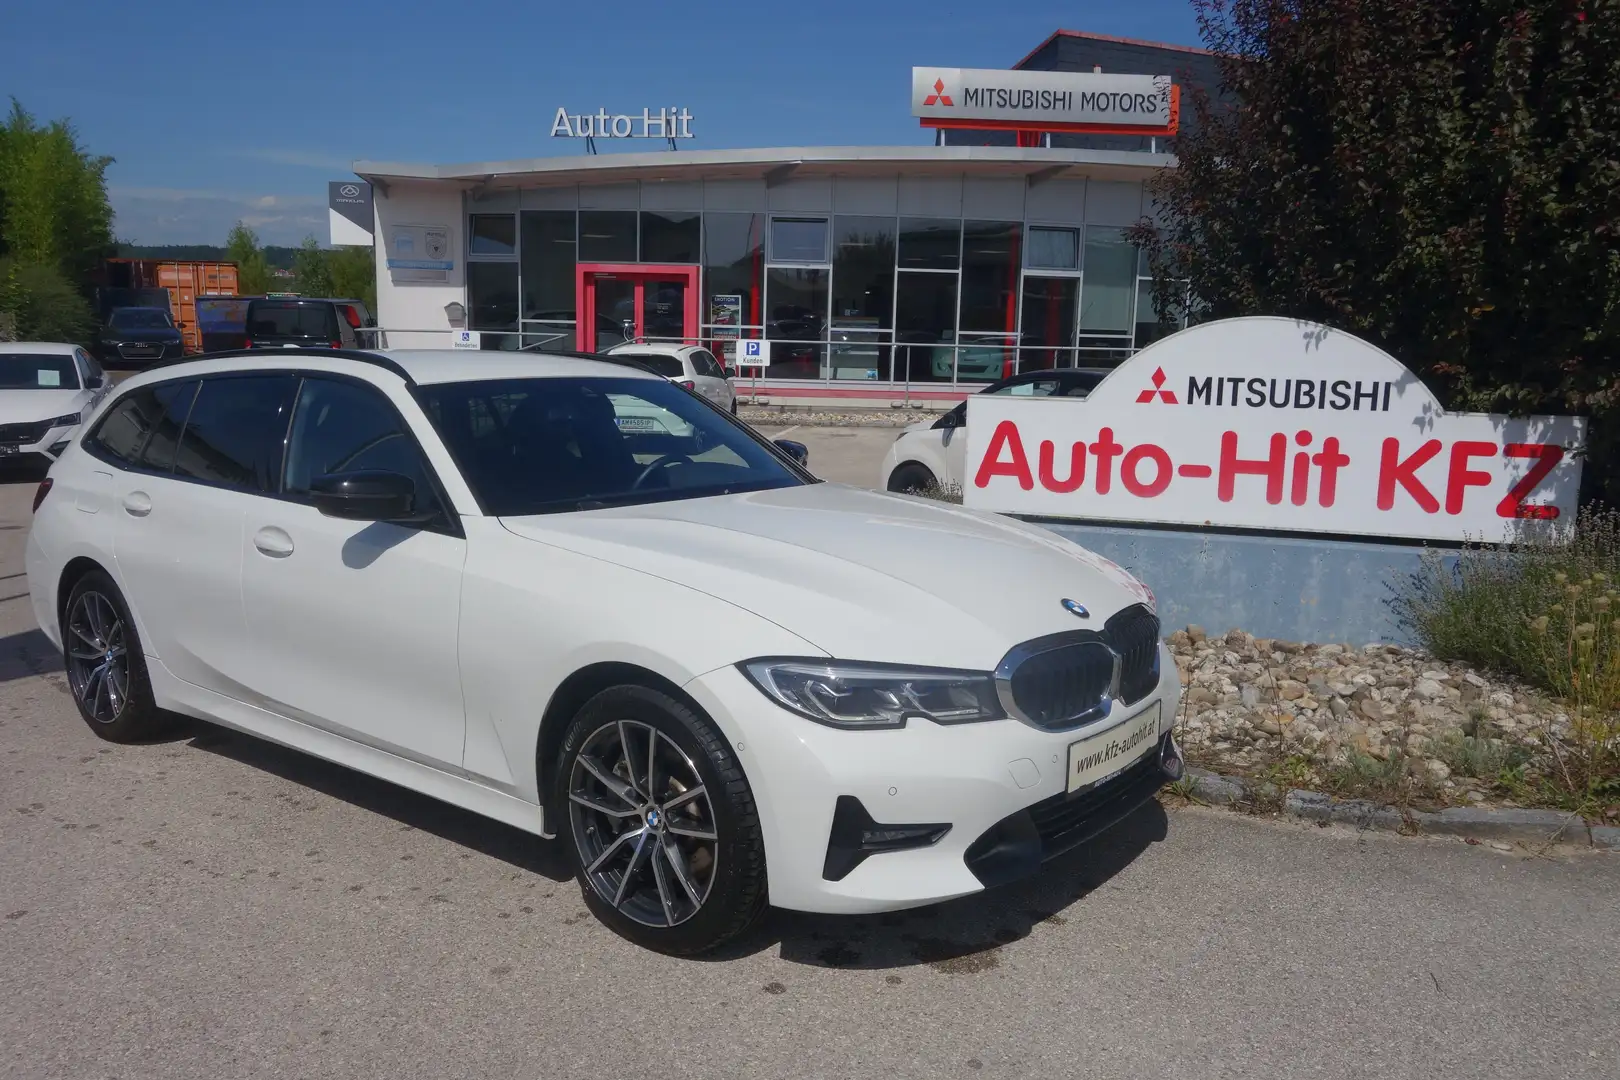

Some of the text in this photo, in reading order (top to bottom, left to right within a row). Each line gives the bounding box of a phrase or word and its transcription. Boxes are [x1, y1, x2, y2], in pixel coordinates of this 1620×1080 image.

[964, 87, 1157, 113] MITSUBISHI MOTORS
[550, 106, 695, 138] Auto Hit
[749, 342, 758, 355] P
[1187, 376, 1392, 412] MITSUBISHI
[974, 420, 1565, 520] Auto-Hit KFZ
[1077, 717, 1156, 774] www.kfz-autohit.at
